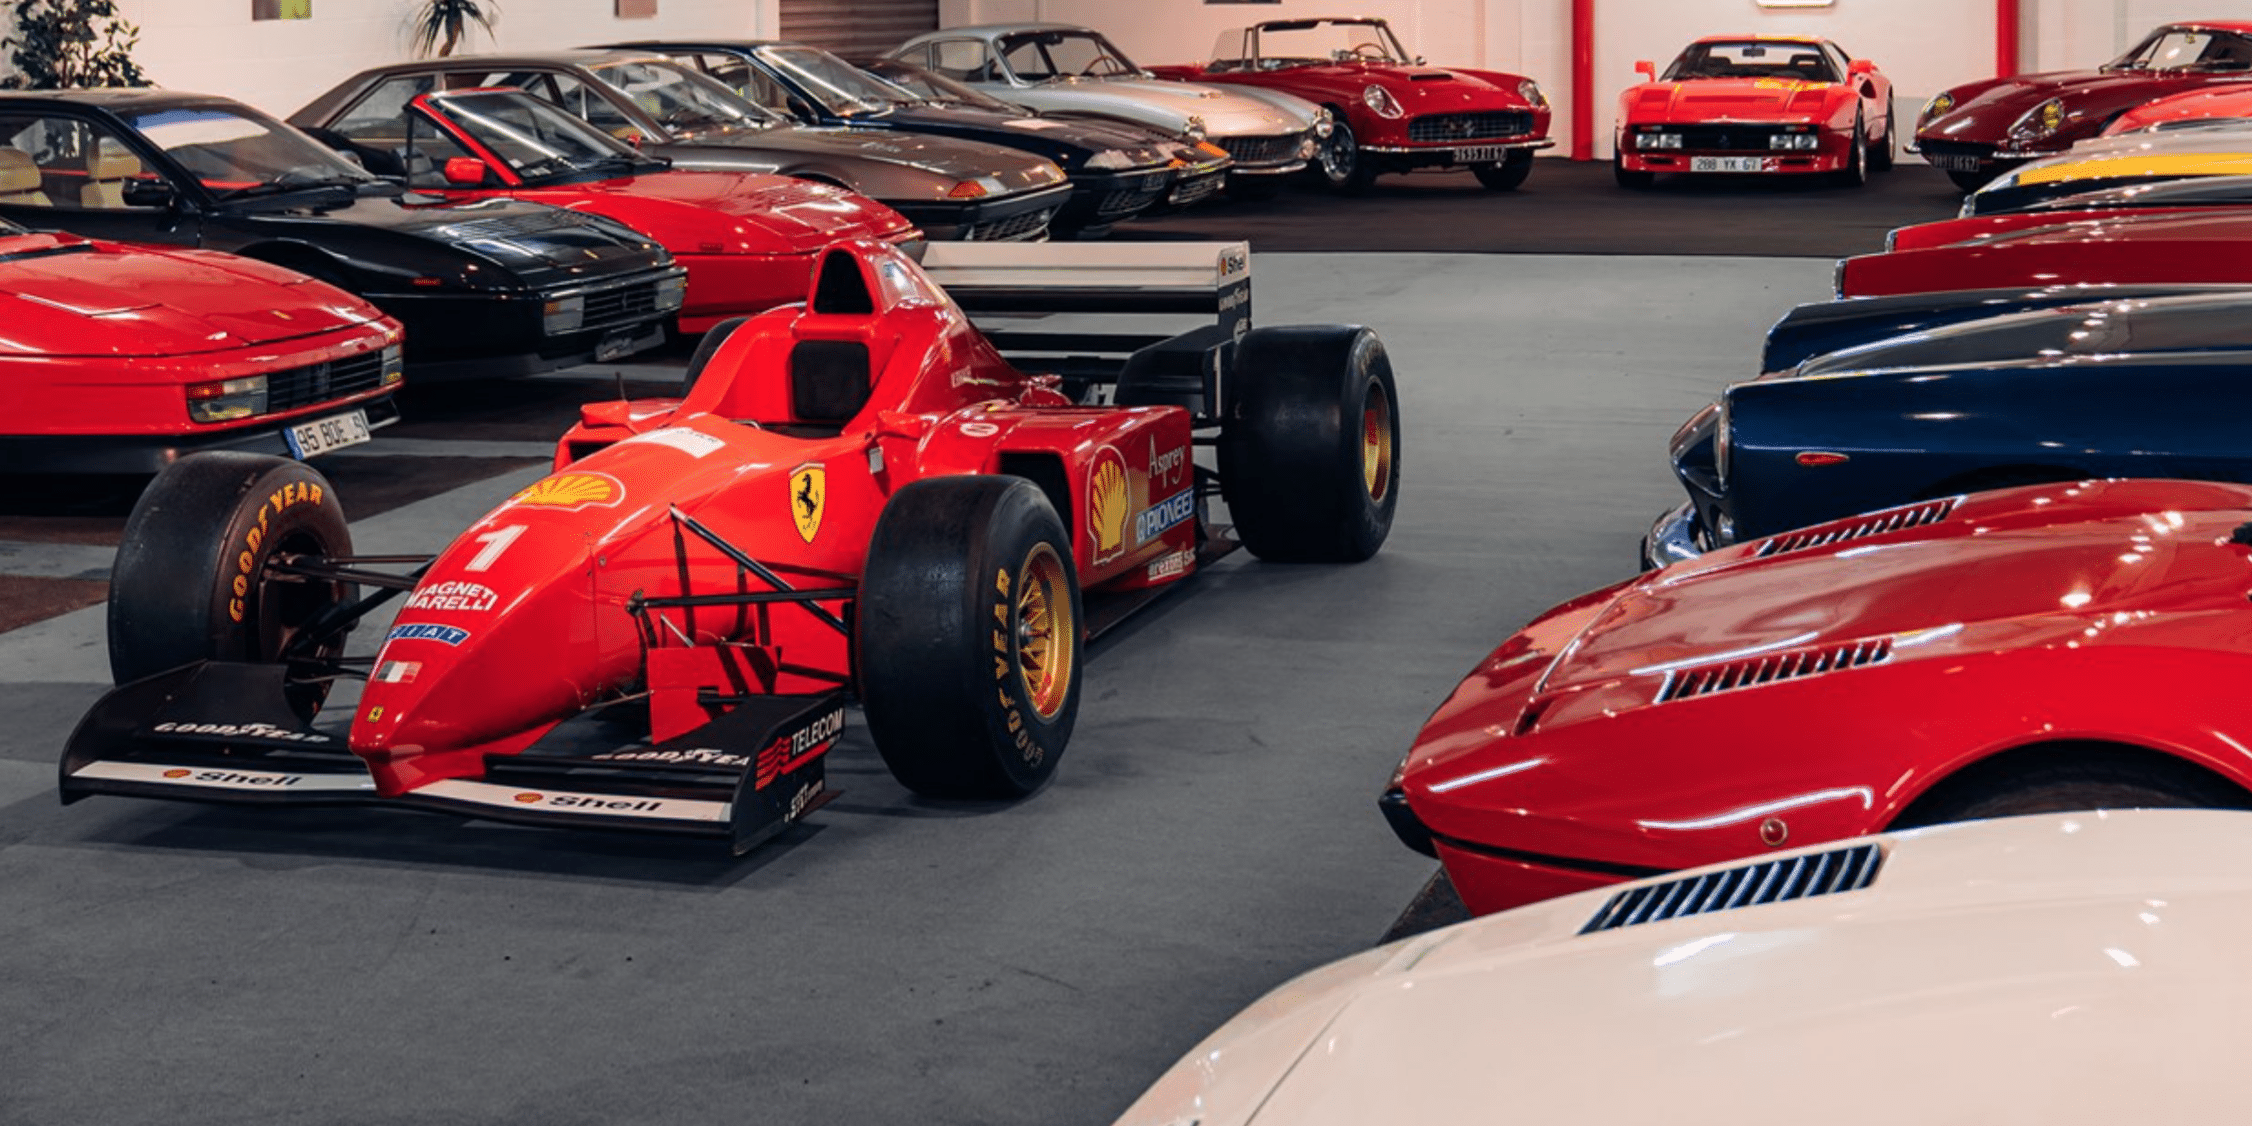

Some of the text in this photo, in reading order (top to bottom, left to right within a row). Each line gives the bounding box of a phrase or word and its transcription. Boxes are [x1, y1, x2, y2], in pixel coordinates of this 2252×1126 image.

[1697, 159, 1756, 170] 288 YX 67
[296, 427, 320, 454] 95
[1150, 434, 1186, 489] Asprey
[464, 524, 529, 572] 1
[791, 707, 843, 757] TELECOM
[590, 748, 750, 766] GOODYEA
[195, 771, 302, 786] Shell
[549, 796, 663, 812] Shell
